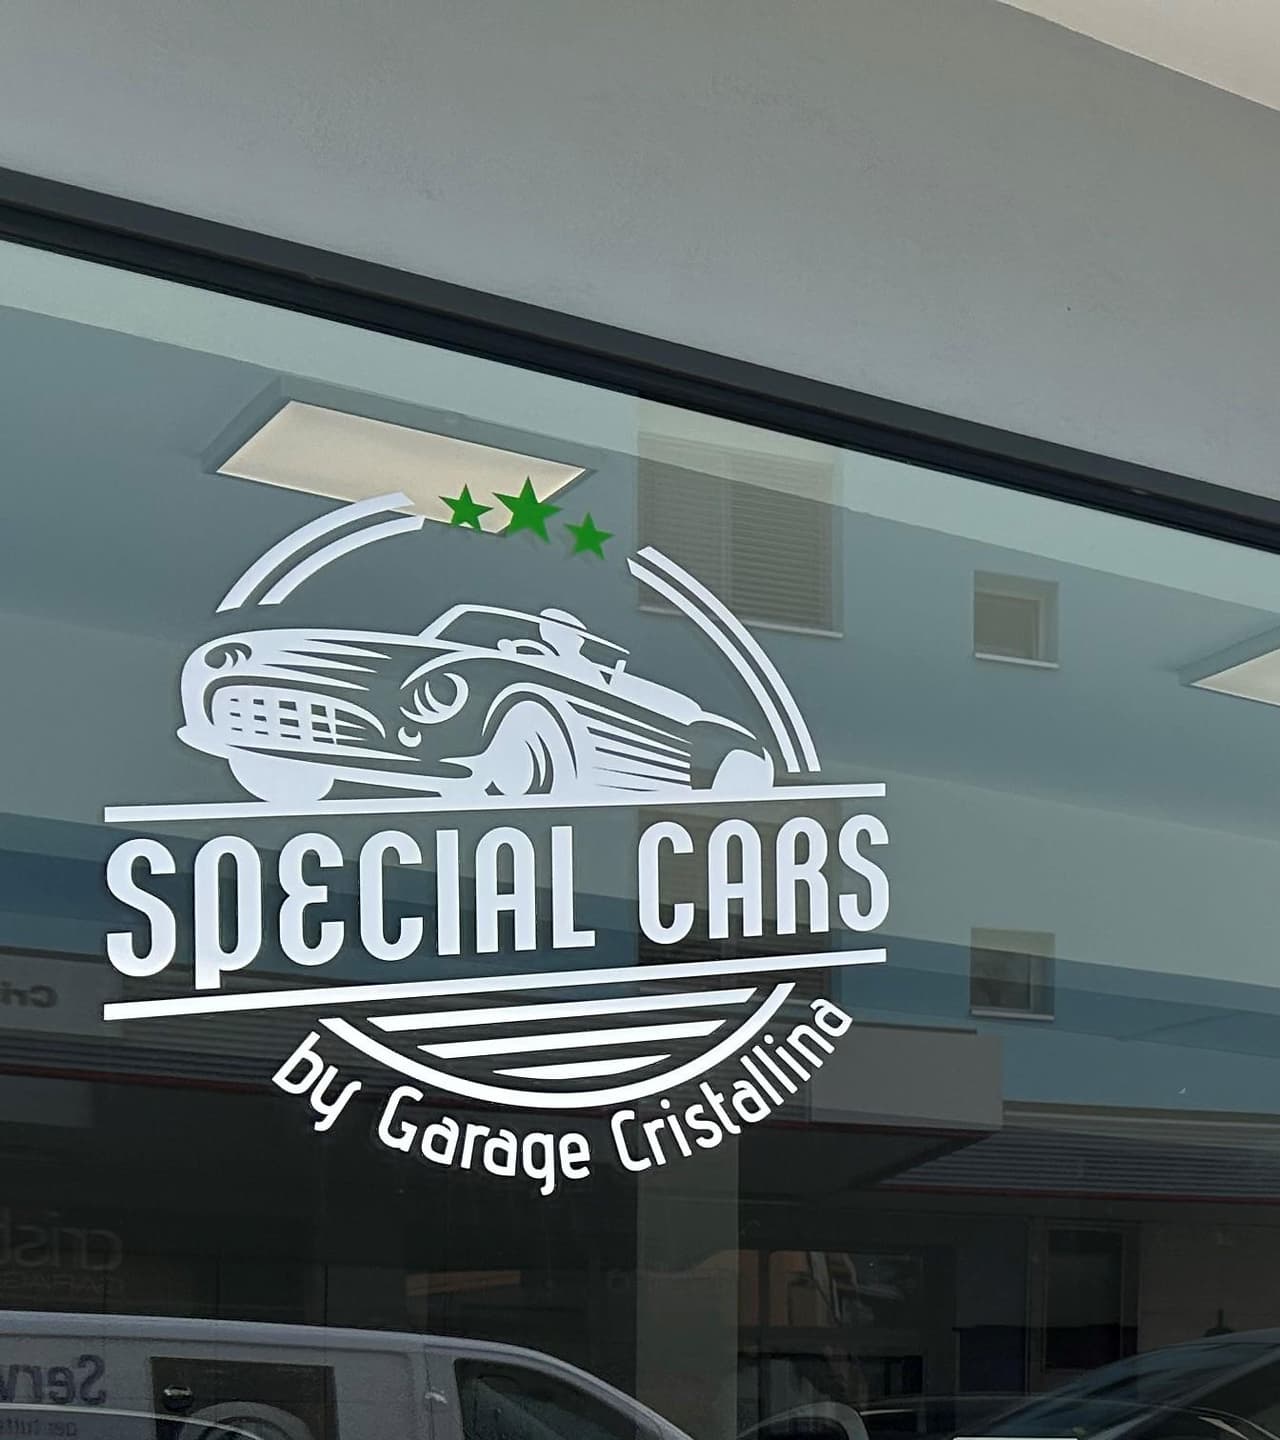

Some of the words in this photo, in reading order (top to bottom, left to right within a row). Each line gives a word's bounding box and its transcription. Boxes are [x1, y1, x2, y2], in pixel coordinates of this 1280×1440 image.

[105, 822, 596, 990] SPECIAL
[637, 814, 890, 946] CARS
[271, 1031, 363, 1134] by
[376, 1085, 592, 1196] Garage
[609, 997, 854, 1173] Cristallina
